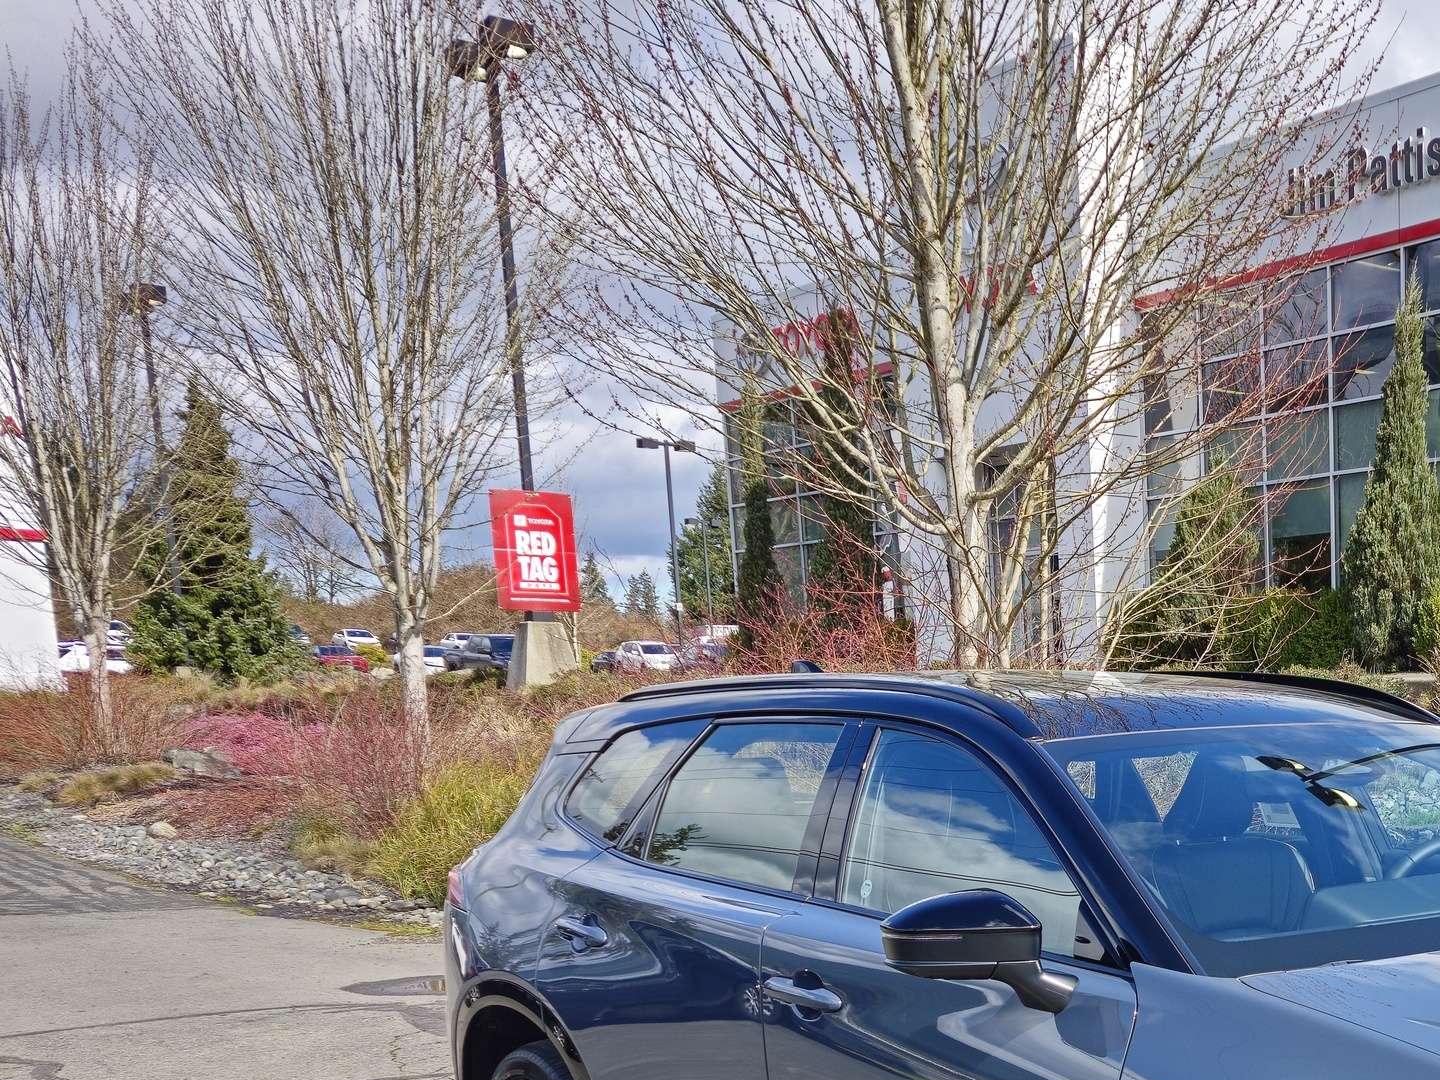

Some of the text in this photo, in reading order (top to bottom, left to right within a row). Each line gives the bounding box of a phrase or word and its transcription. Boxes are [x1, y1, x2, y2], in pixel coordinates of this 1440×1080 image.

[527, 518, 555, 526] TOYOTA
[515, 530, 556, 556] RED
[517, 556, 559, 583] TAG
